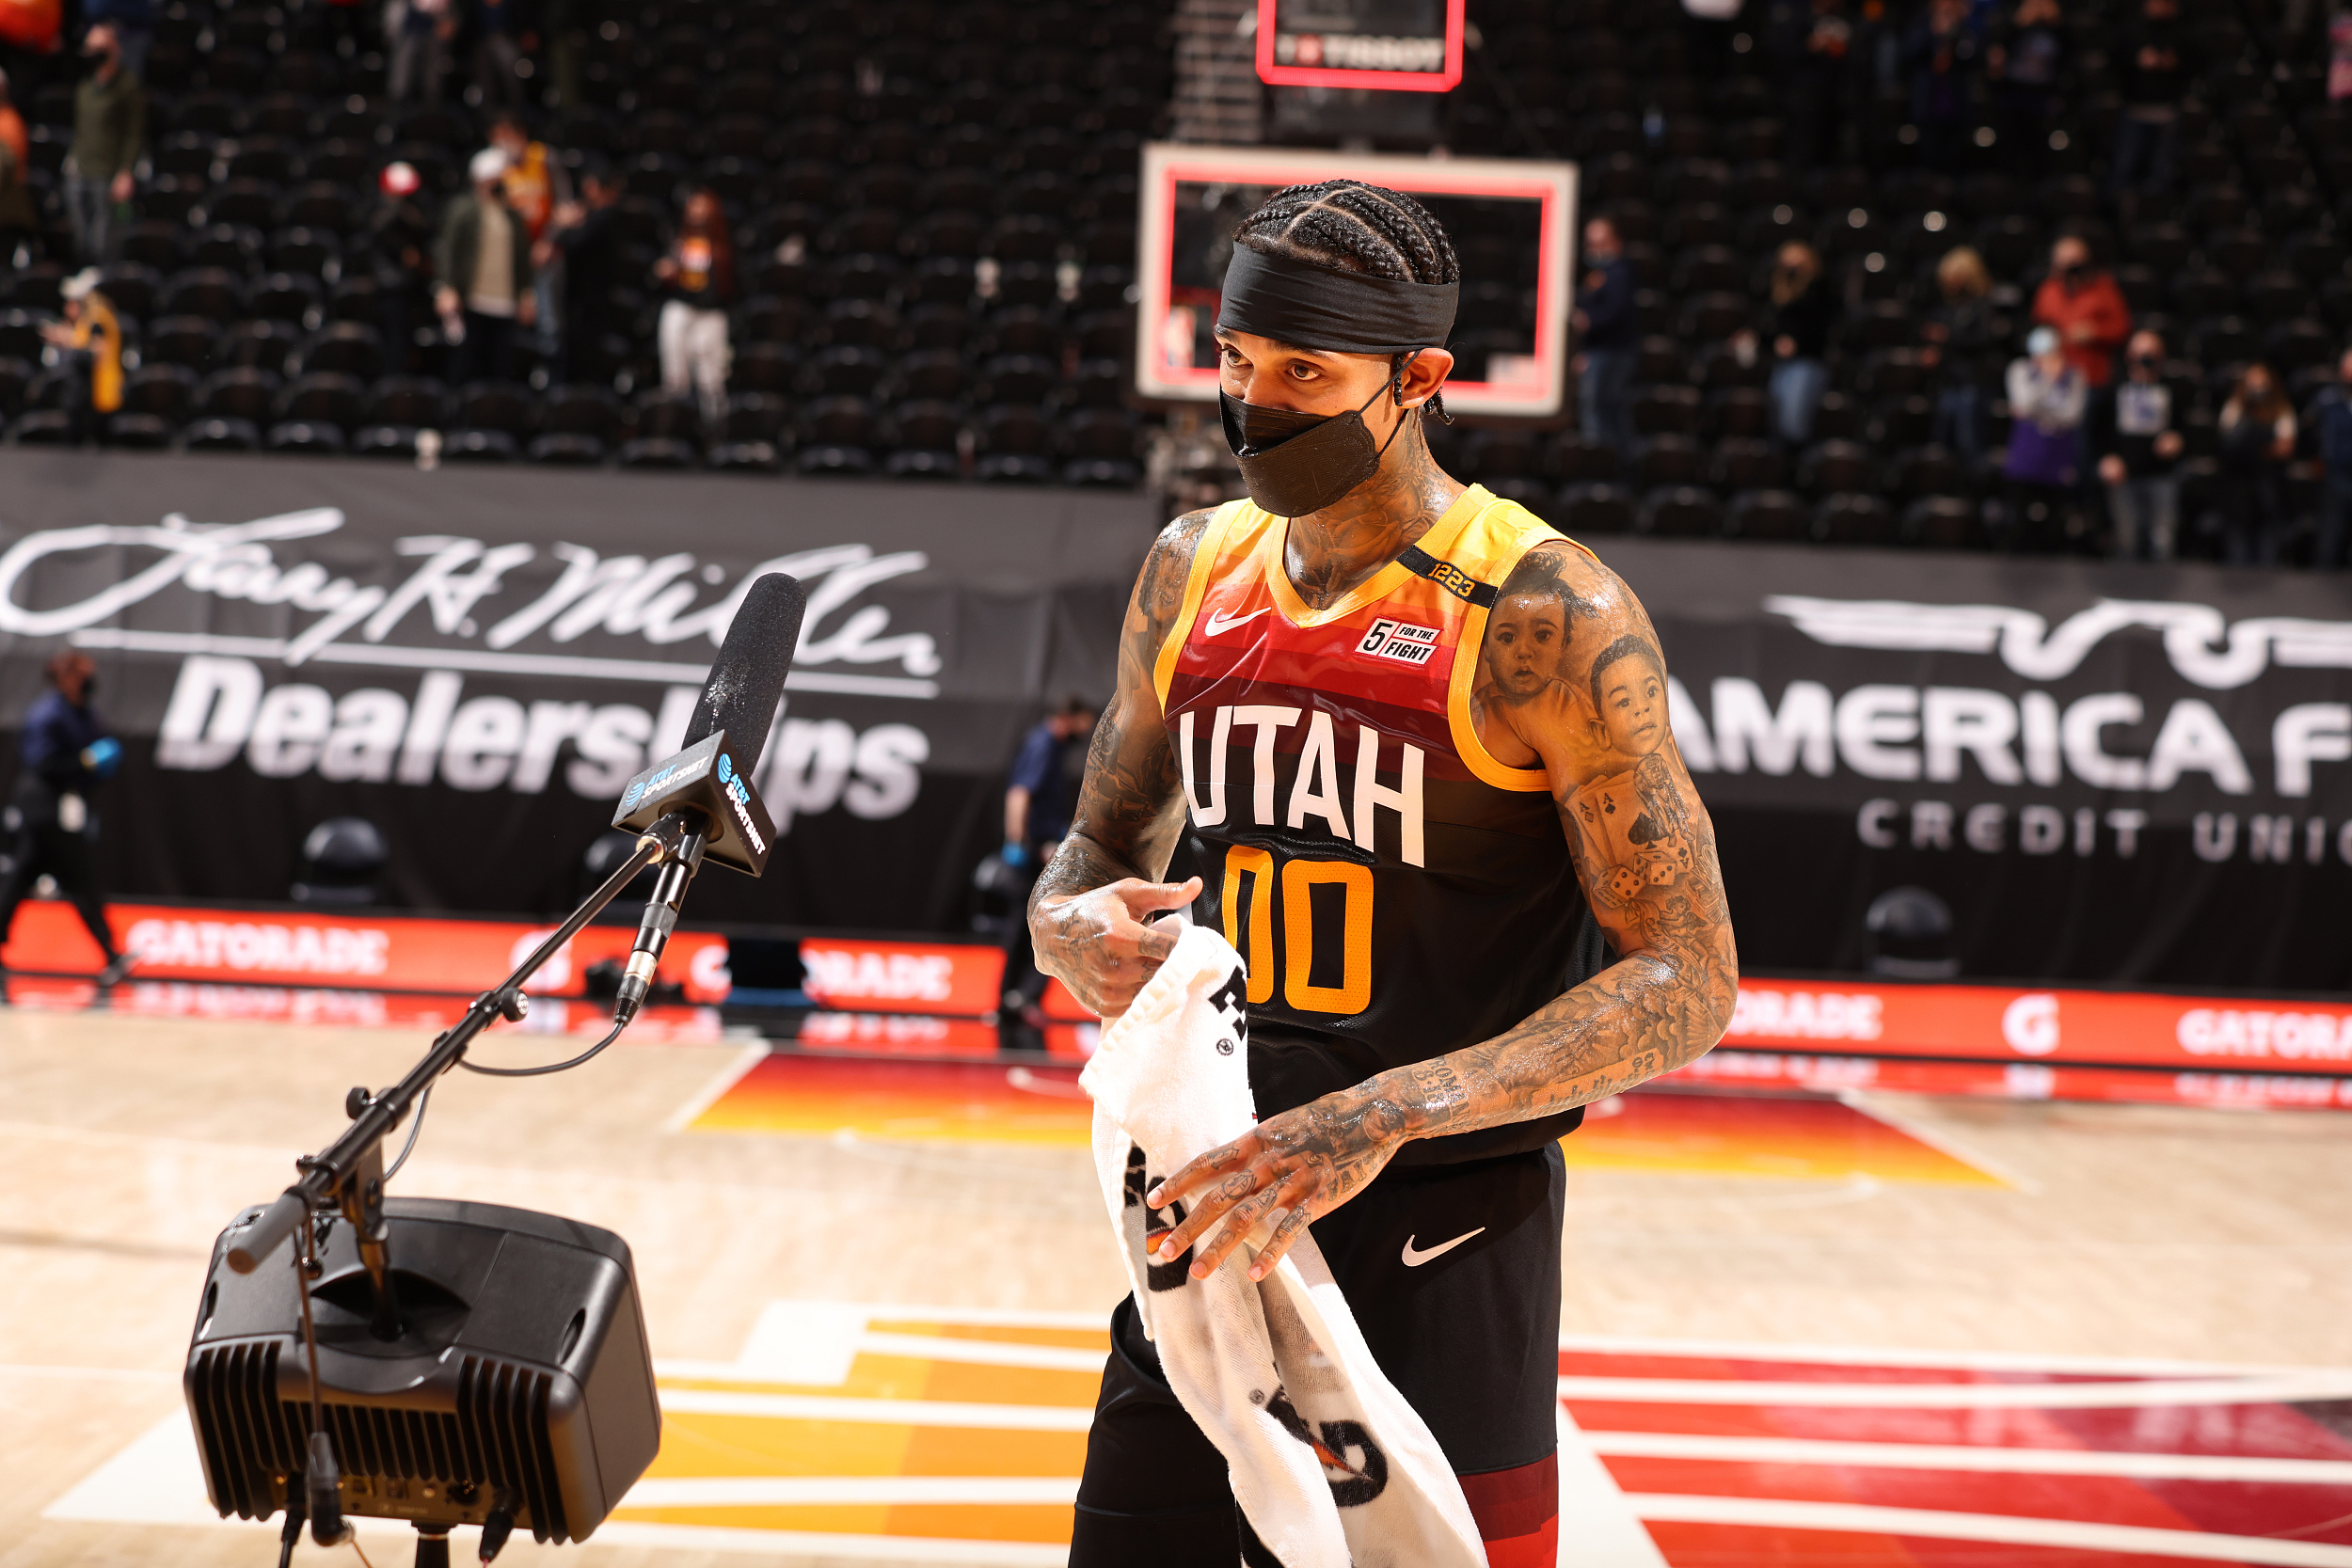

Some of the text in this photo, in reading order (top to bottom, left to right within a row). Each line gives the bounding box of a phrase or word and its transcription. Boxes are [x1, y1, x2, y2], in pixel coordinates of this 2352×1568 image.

[1428, 562, 1476, 597] 1223
[1362, 622, 1435, 651] 5 FOR THE
[1384, 641, 1431, 661] FIGHT
[156, 654, 930, 837] Dealersps
[641, 755, 709, 800] SPORTSNET
[729, 773, 751, 805] AT&T
[1180, 705, 1425, 868] UTAH
[725, 782, 767, 856] SPORTSNET
[1856, 799, 2352, 868] CREDIT UNI
[125, 919, 390, 976] GATORADE
[1223, 844, 1375, 1015] 00
[2001, 993, 2061, 1056] G
